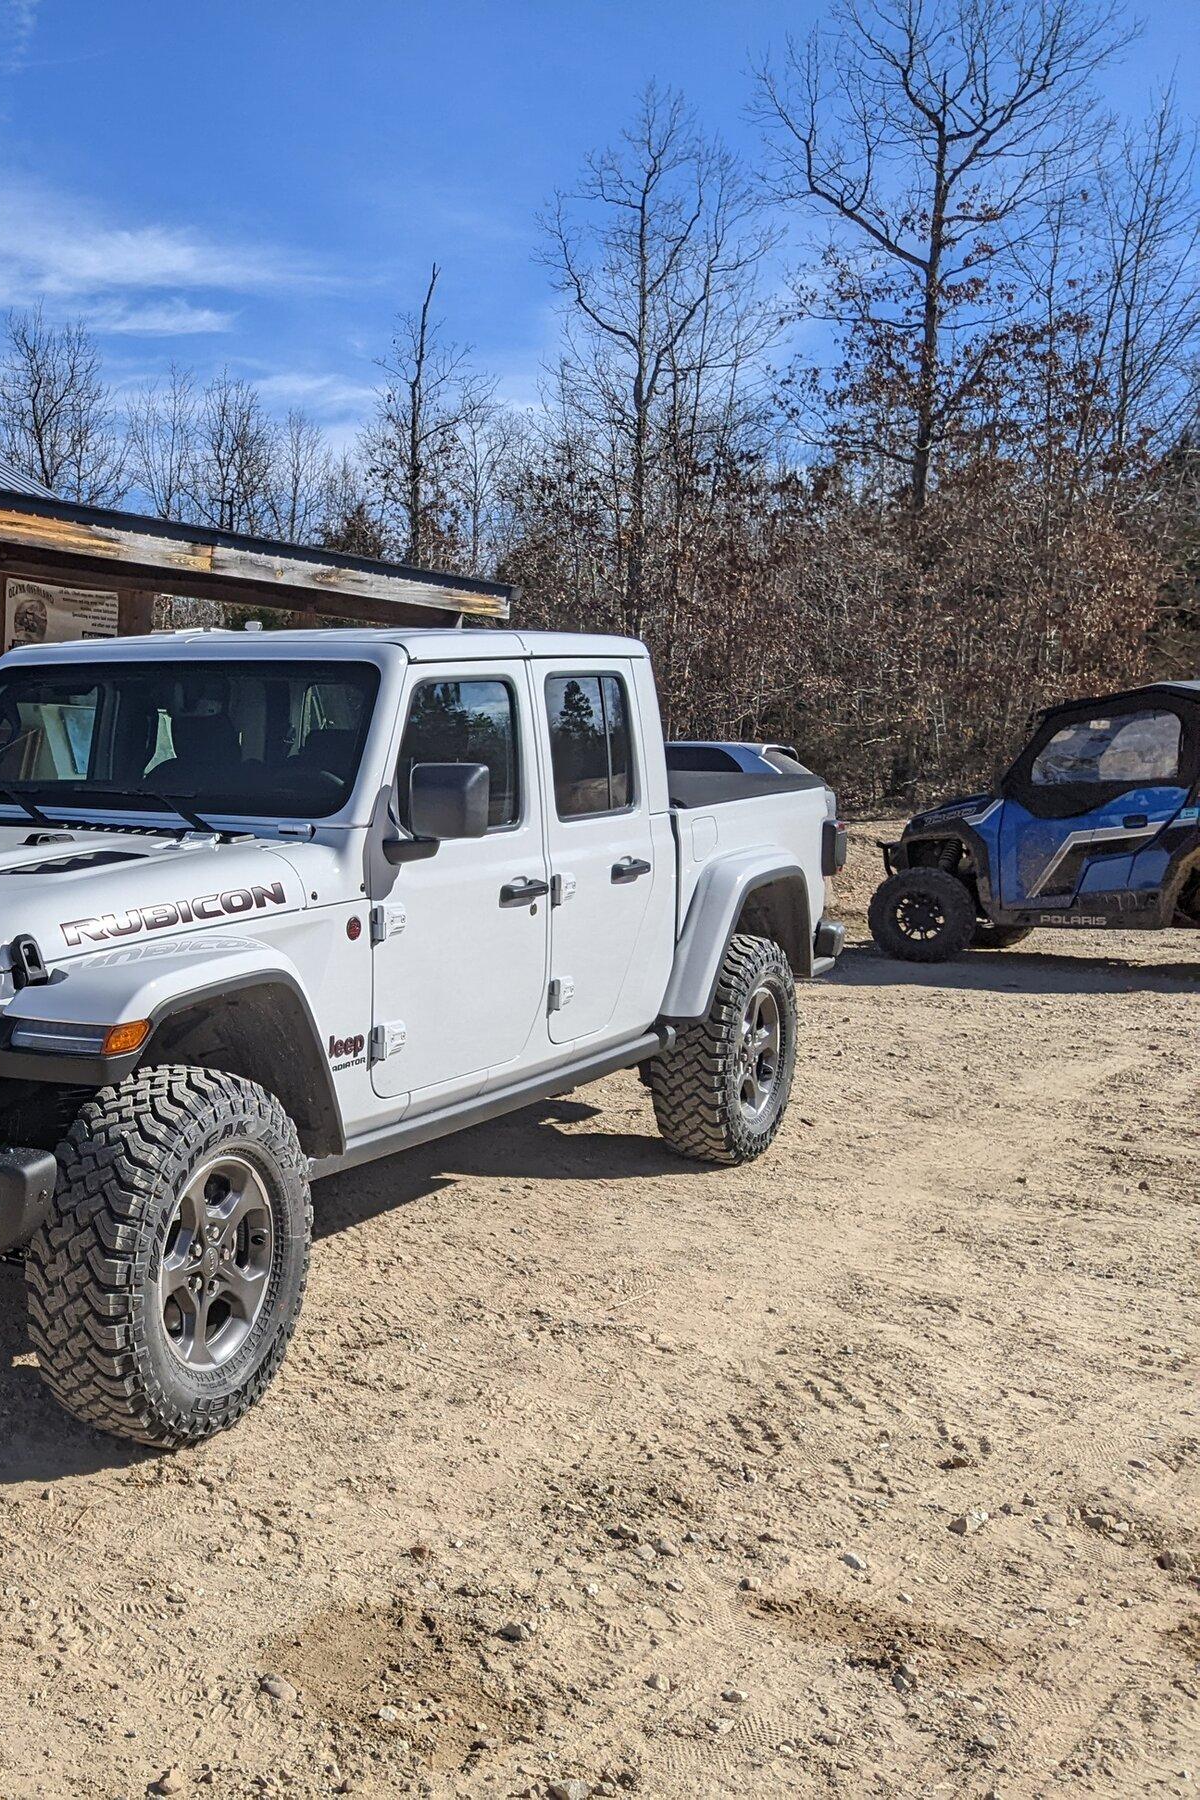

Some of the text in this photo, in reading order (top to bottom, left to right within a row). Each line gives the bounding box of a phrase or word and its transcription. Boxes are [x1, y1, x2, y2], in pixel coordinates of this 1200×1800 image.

[59, 881, 287, 947] RUBICON
[1040, 914, 1108, 927] POLARIS
[328, 1033, 365, 1059] Jeep
[331, 1056, 366, 1073] ADIATOR
